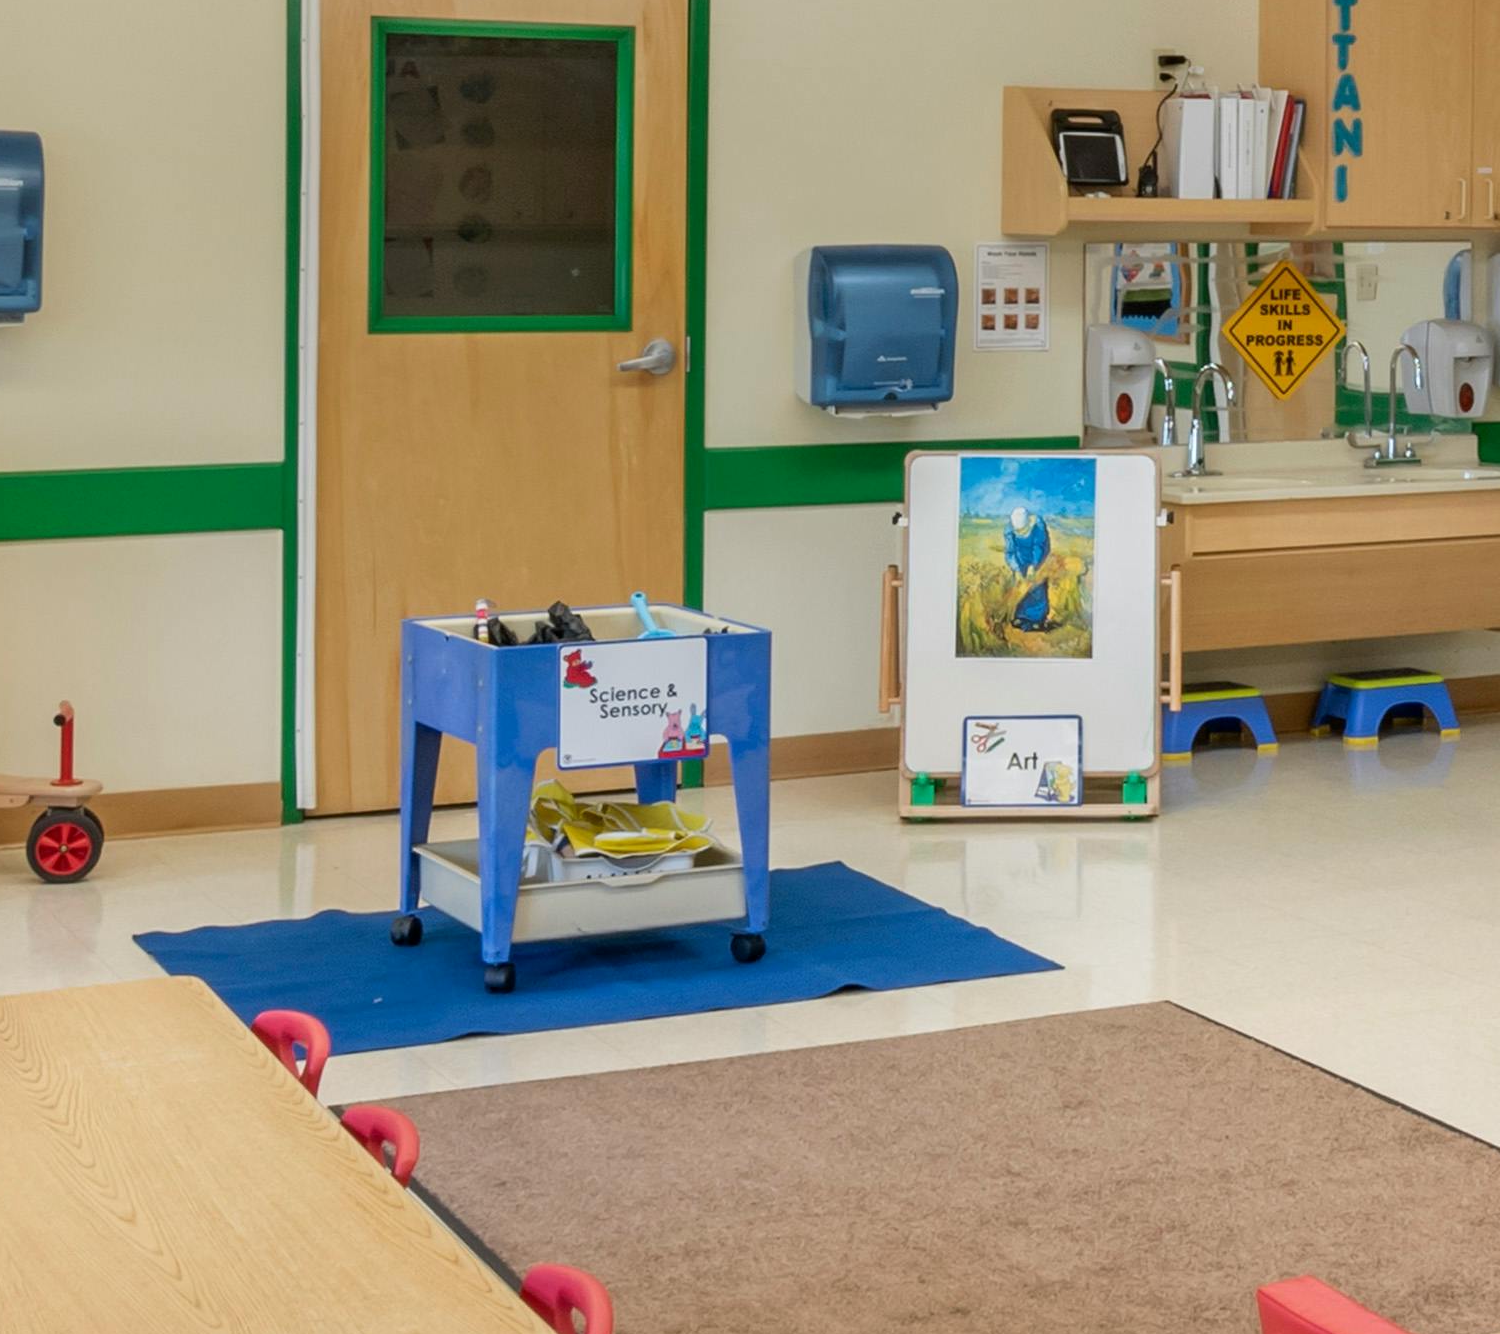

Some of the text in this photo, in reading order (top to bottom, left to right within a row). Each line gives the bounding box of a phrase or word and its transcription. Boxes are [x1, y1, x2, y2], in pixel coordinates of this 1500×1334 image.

[1270, 289, 1301, 300] LIFE
[1260, 304, 1311, 316] SKILLS
[1277, 320, 1293, 331] IN
[1246, 334, 1324, 346] PROGRESS
[589, 683, 678, 704] Science &
[599, 702, 669, 718] Sensory
[1006, 751, 1039, 770] Art
